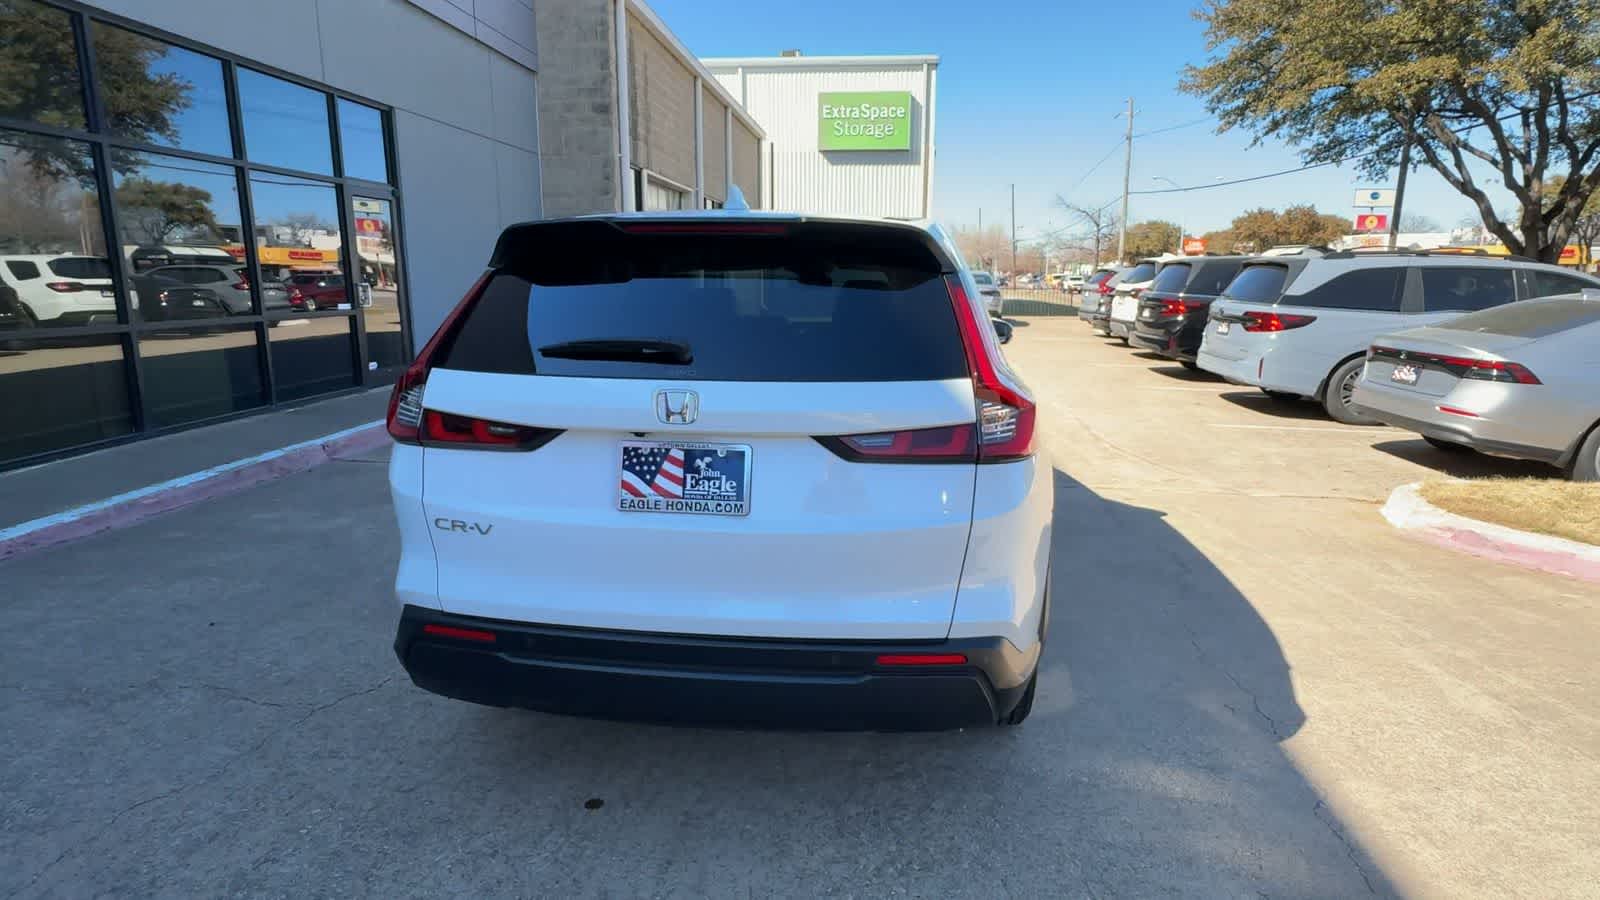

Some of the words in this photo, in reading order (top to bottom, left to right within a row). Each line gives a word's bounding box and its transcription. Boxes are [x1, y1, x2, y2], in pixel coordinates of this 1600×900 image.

[822, 104, 905, 120] ExtraSpace
[834, 120, 894, 138] Storage
[699, 468, 721, 479] John
[685, 473, 737, 495] Eagle
[620, 498, 662, 511] EAGLE
[665, 500, 744, 514] HONDA.COM
[434, 517, 493, 535] CR-V
